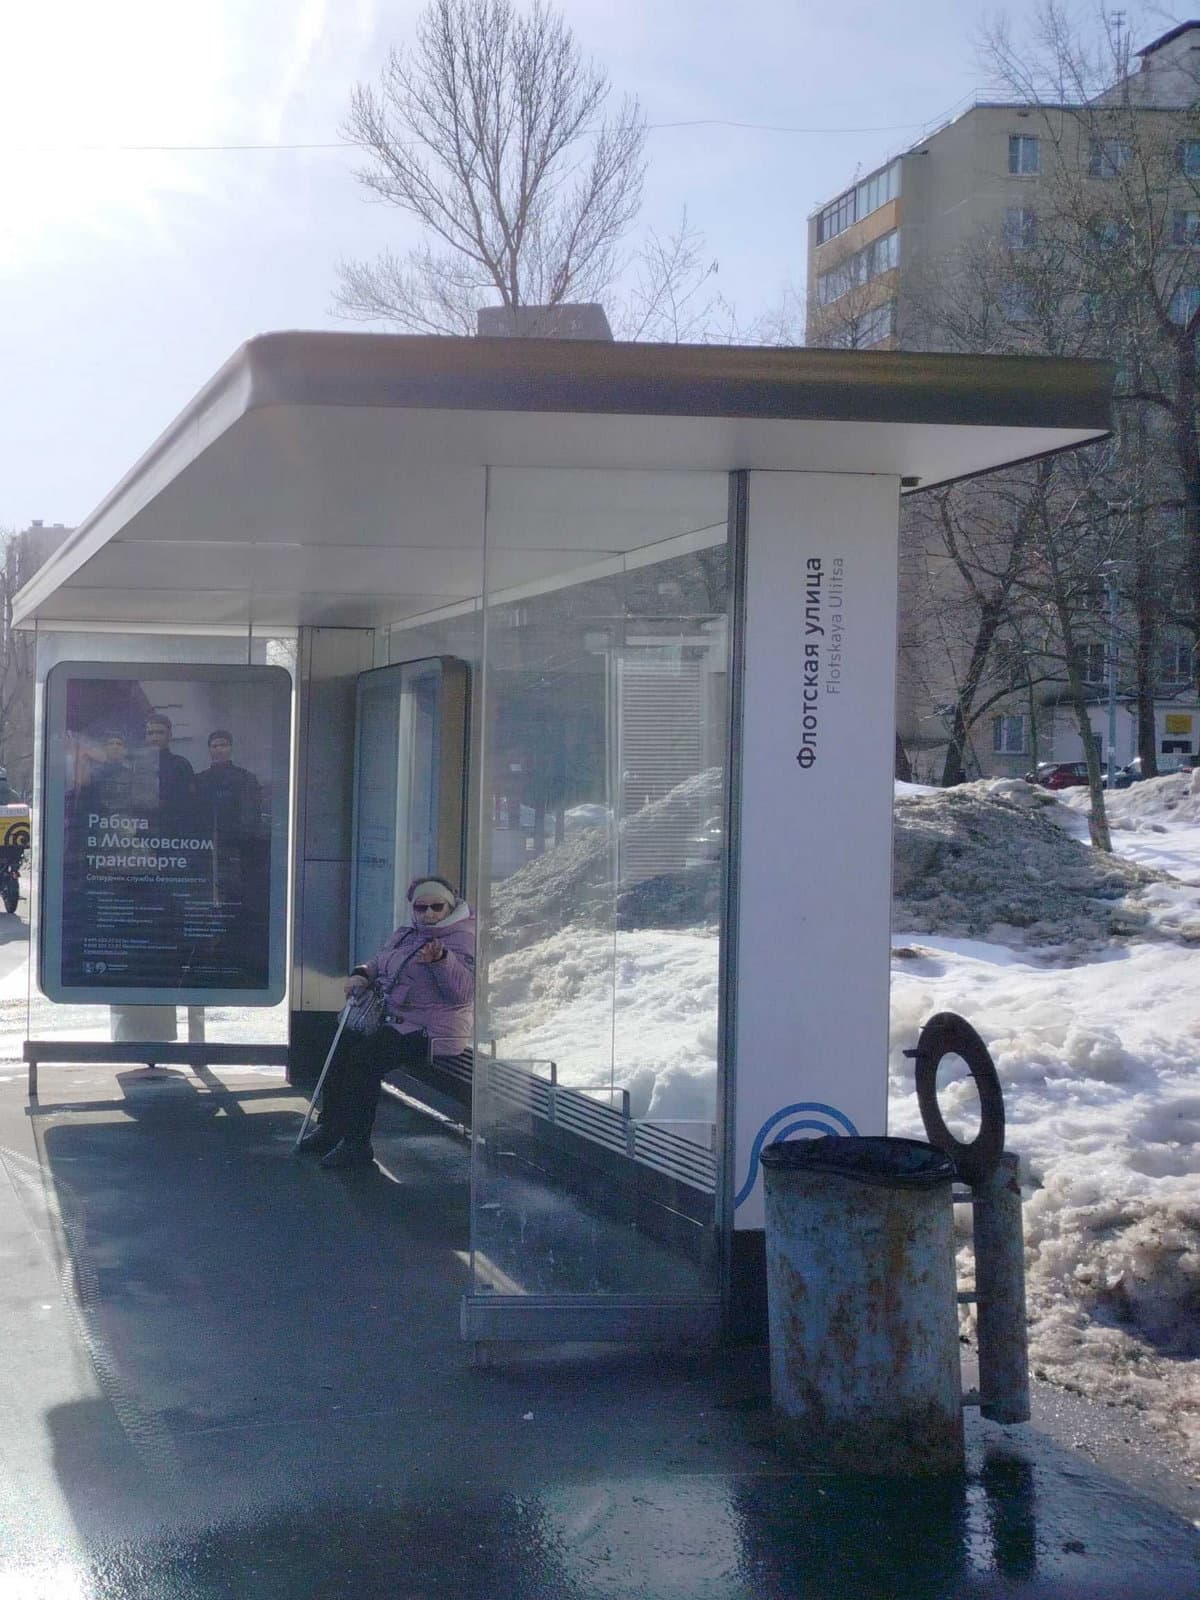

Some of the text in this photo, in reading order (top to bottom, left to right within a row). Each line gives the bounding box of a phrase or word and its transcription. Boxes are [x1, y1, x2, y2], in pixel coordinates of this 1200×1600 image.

[826, 557, 845, 694] Flotskaya Ulitsa
[797, 557, 824, 769] Флотская улица
[88, 813, 149, 830] Работа
[87, 832, 214, 850] в Московском
[86, 855, 188, 871] транспорте
